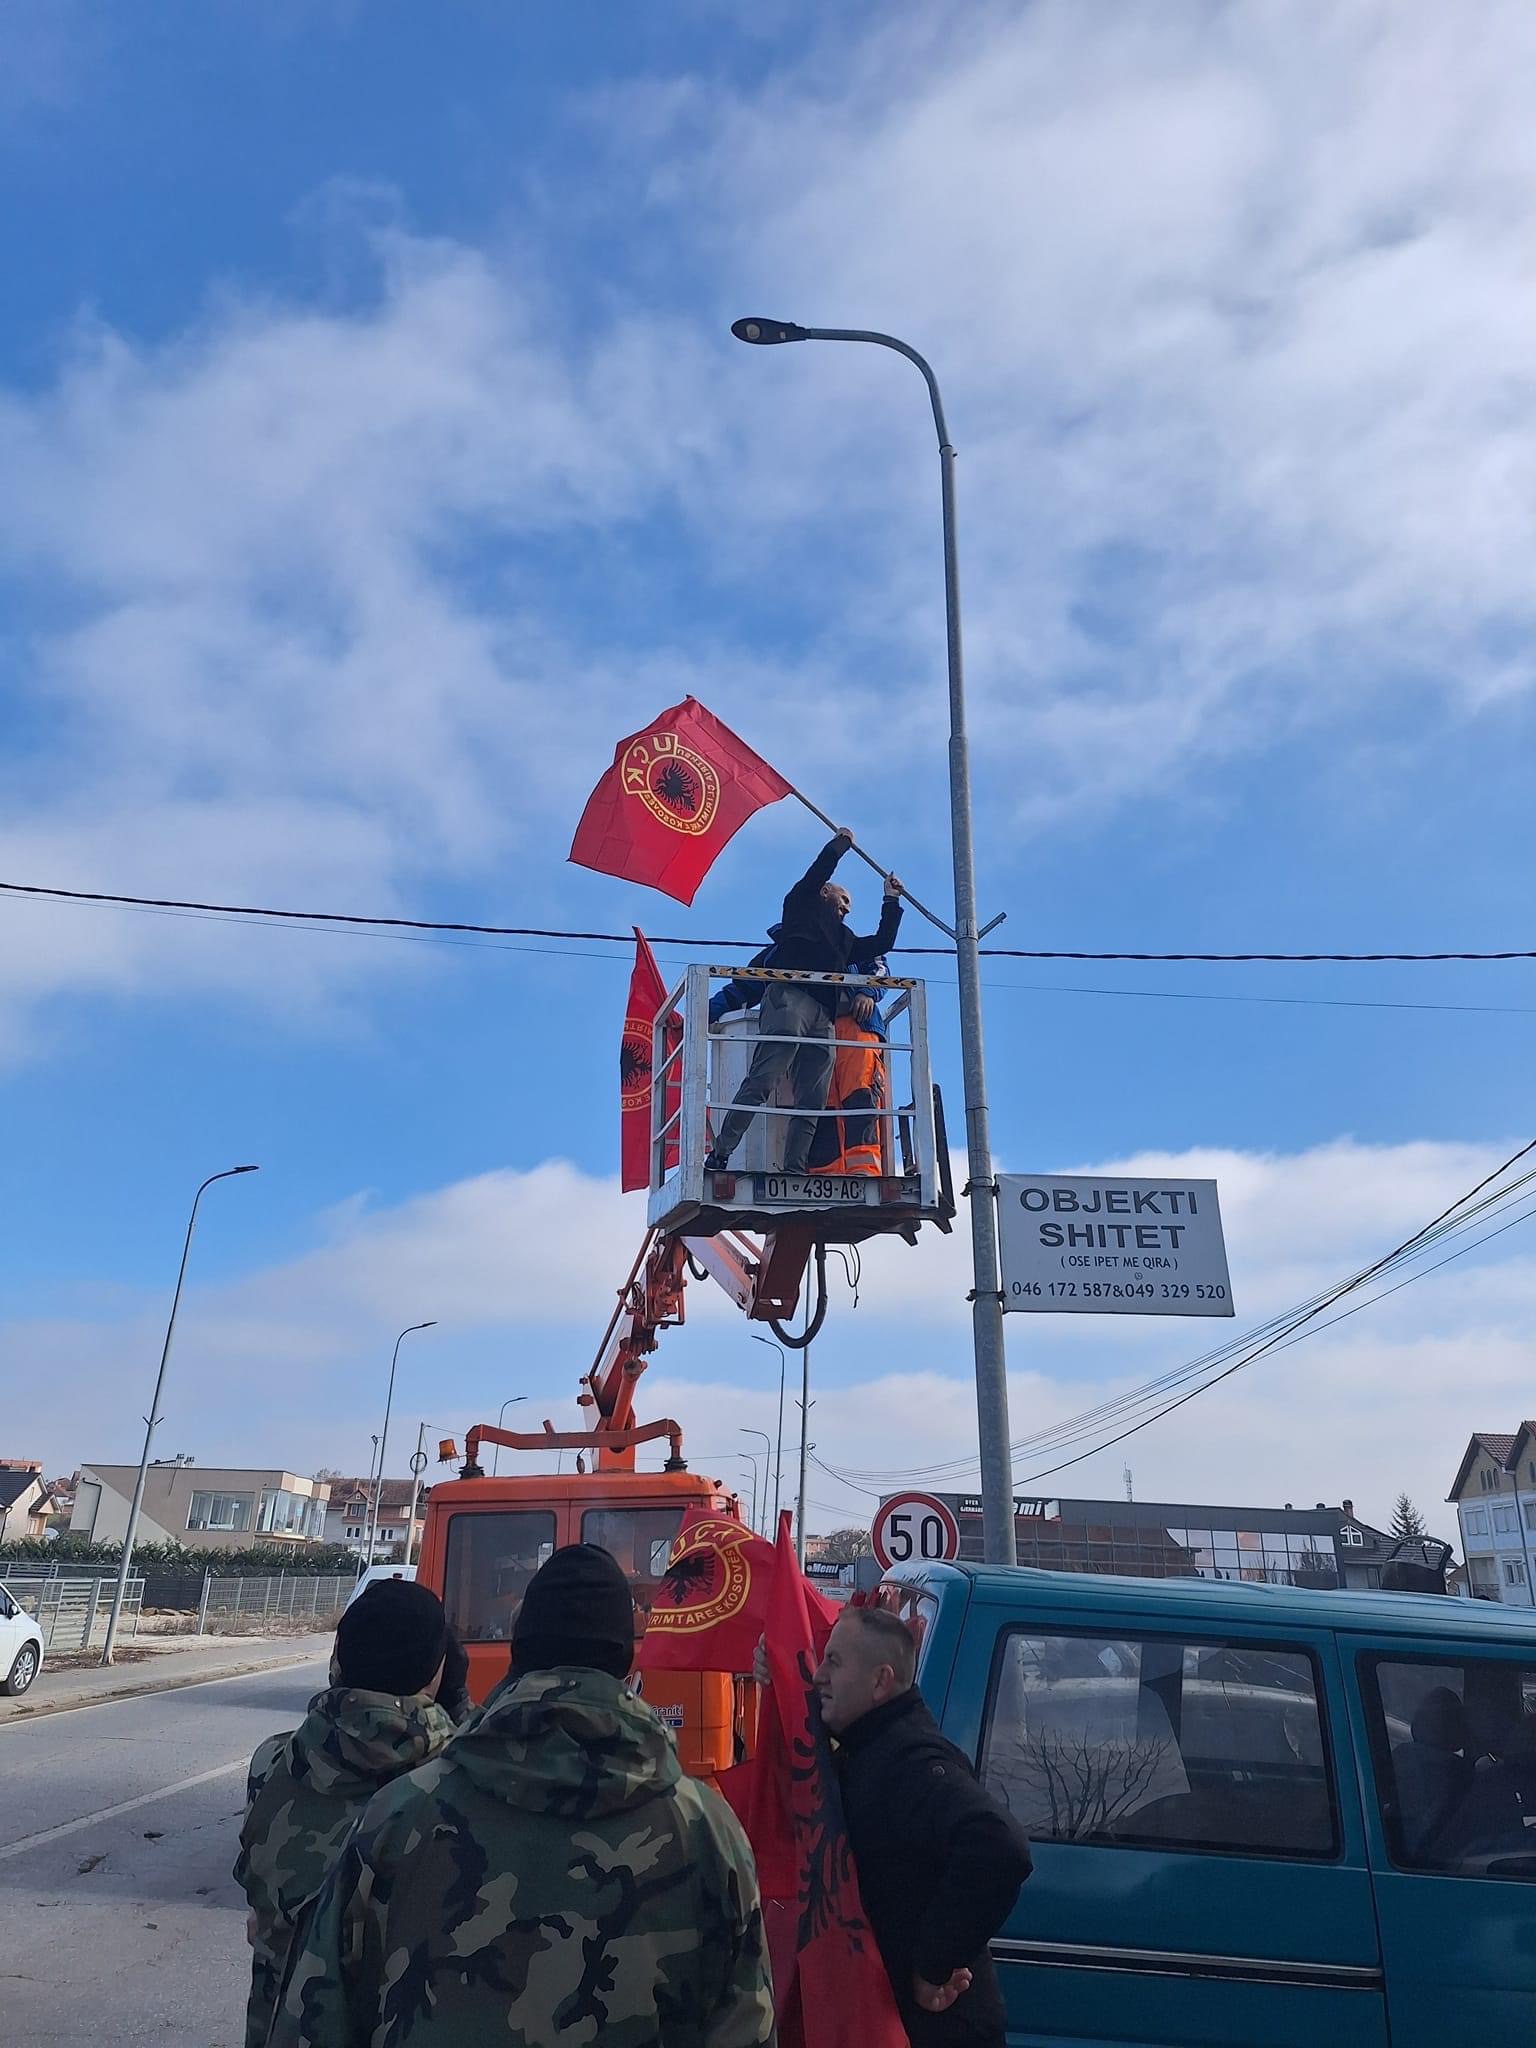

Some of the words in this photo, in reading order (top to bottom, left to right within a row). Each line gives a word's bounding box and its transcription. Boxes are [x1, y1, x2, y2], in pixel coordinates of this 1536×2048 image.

[769, 1178, 787, 1198] 01
[1020, 1188, 1197, 1214] OBJEKTI
[1039, 1223, 1185, 1249] SHITET
[1095, 1256, 1119, 1267] IPET
[1123, 1257, 1139, 1268] ME
[1012, 1282, 1041, 1296] 046
[1049, 1283, 1077, 1297] 172
[1162, 1285, 1189, 1298] 329
[1197, 1285, 1225, 1299] 520
[890, 1514, 943, 1561] 50
